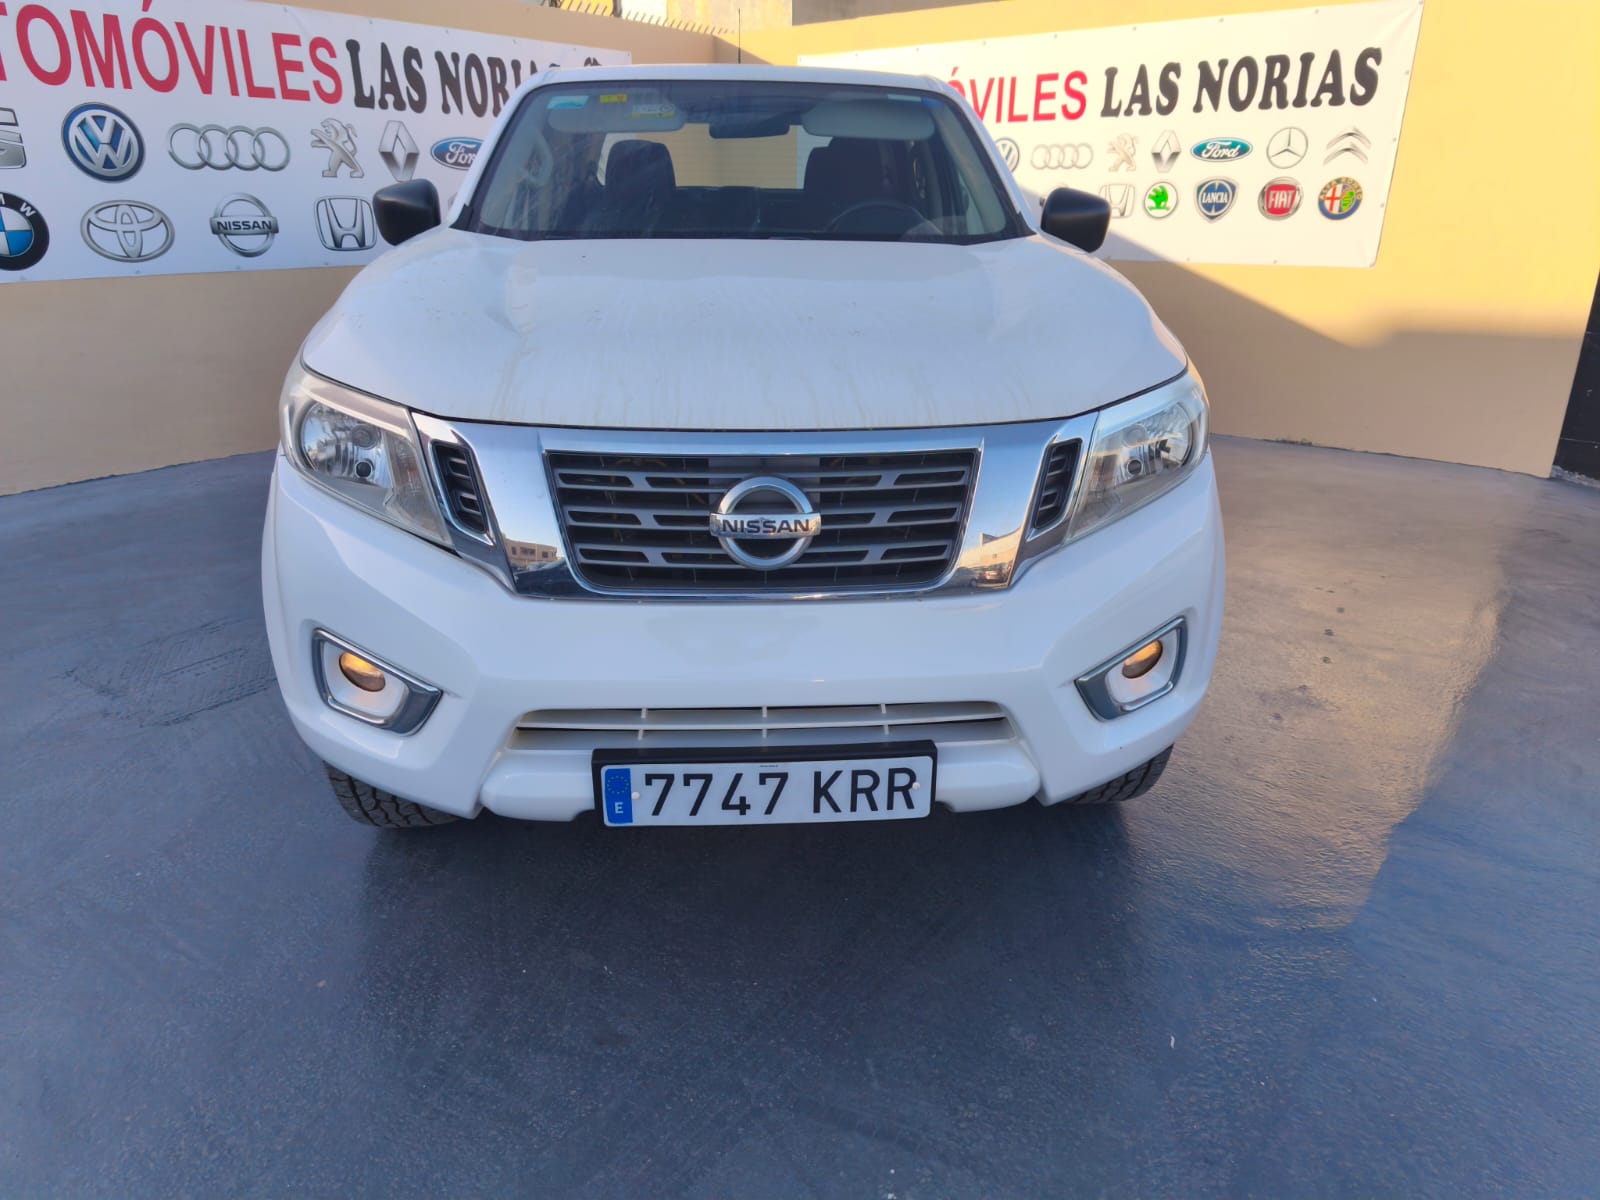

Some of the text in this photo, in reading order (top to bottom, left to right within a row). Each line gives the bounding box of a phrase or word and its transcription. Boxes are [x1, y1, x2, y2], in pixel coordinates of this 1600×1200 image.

[0, 0, 343, 104] OMÓVILES
[346, 39, 427, 114] LAS
[1100, 62, 1182, 118] LAS
[1192, 46, 1382, 112] NORIAS
[1202, 141, 1241, 158] Ford
[1202, 191, 1228, 203] LANCIA
[1267, 189, 1296, 209] FIAT
[216, 220, 273, 231] NISSAN
[721, 518, 810, 533] NISSAN
[644, 767, 917, 817] 7747 KRR
[614, 801, 624, 814] E
